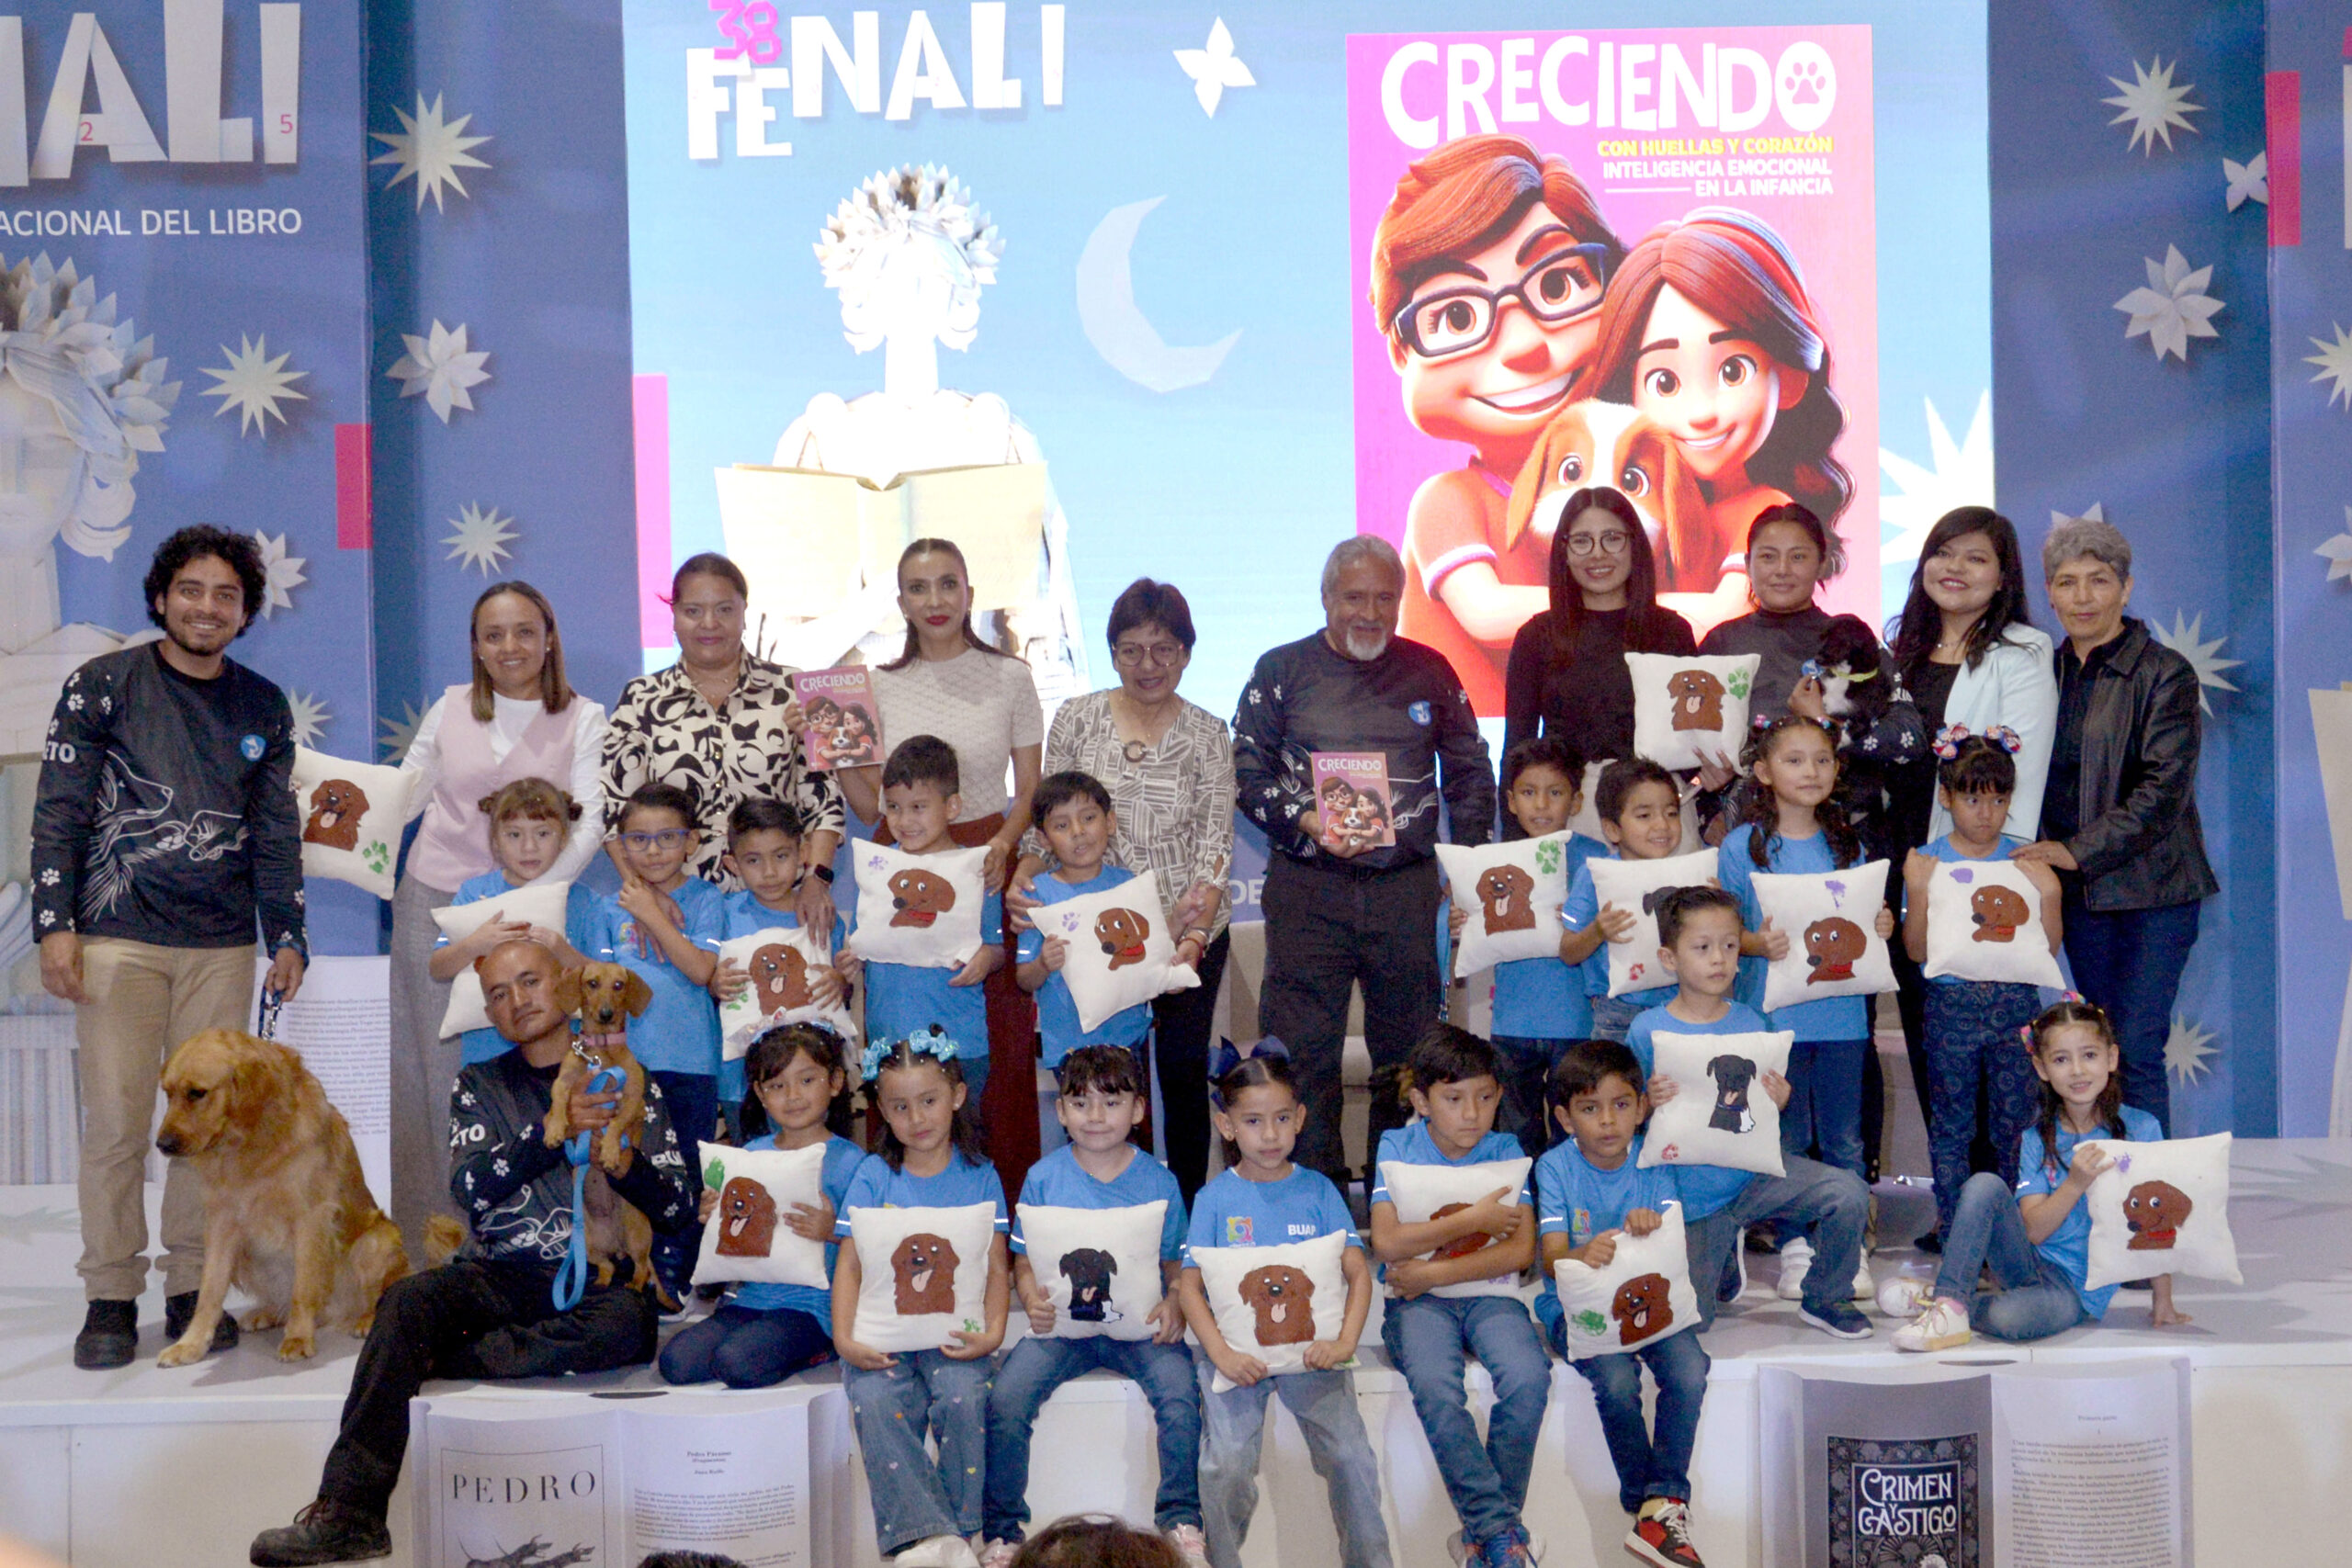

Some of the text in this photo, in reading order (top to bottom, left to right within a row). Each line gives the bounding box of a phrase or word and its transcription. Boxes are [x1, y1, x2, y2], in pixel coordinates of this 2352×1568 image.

[708, 0, 783, 64] 38
[1381, 35, 1837, 150] CRECIENDO
[1597, 132, 1834, 157] CON HUELLAS Y CORAZÓN
[1602, 158, 1832, 179] INTELIGENCIA EMOCIONAL
[1695, 177, 1834, 197] EN LA INFANCIA
[141, 209, 200, 236] DEL
[209, 209, 302, 235] LIBRO
[799, 672, 865, 694] CRECIENDO
[1317, 758, 1383, 773] CRECIENDO
[1287, 1224, 1317, 1236] BUAP
[452, 1470, 596, 1504] PEDRO
[1860, 1468, 1952, 1507] CRIMEN
[1858, 1505, 1957, 1536] CASTIGO
[1889, 1503, 1899, 1519] Y
